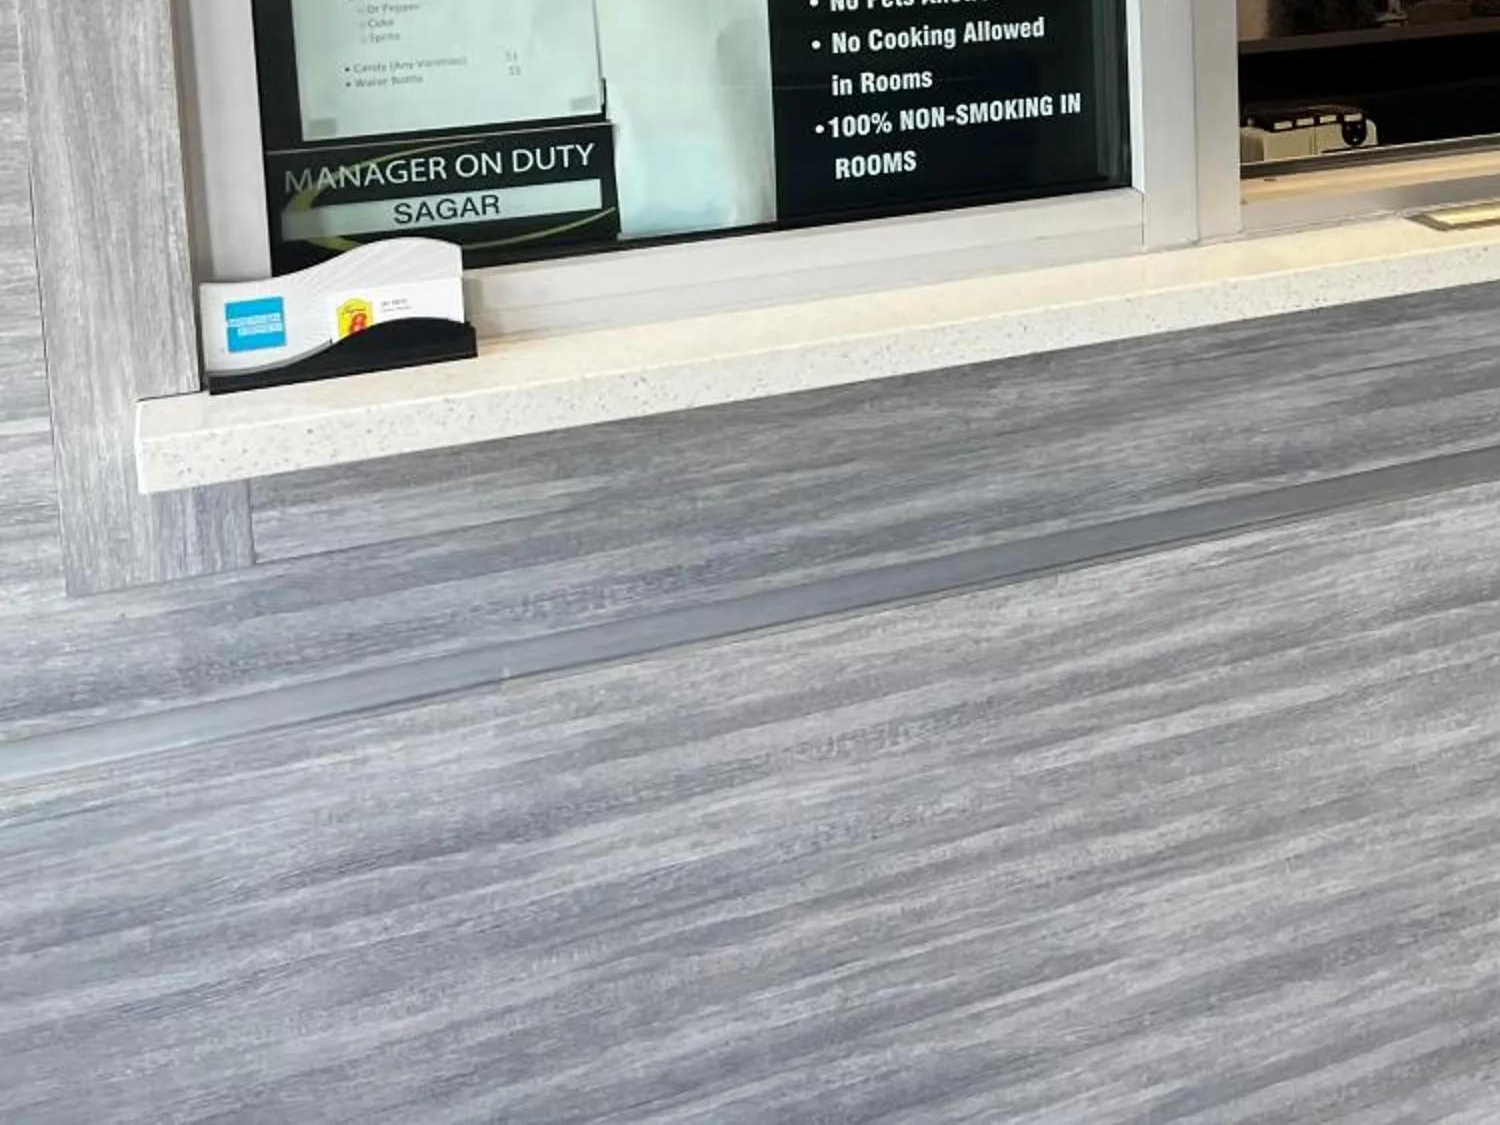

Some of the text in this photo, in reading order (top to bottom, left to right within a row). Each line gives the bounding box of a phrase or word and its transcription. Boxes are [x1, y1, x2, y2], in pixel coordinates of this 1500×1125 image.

[831, 17, 1045, 53] No Cooking Allowed
[831, 71, 933, 96] in Rooms
[828, 92, 1082, 138] 100% NON-SMOKING IN
[284, 142, 596, 194] MANAGER ON DUTY
[835, 150, 917, 179] ROOMS
[393, 194, 500, 225] SAGAR
